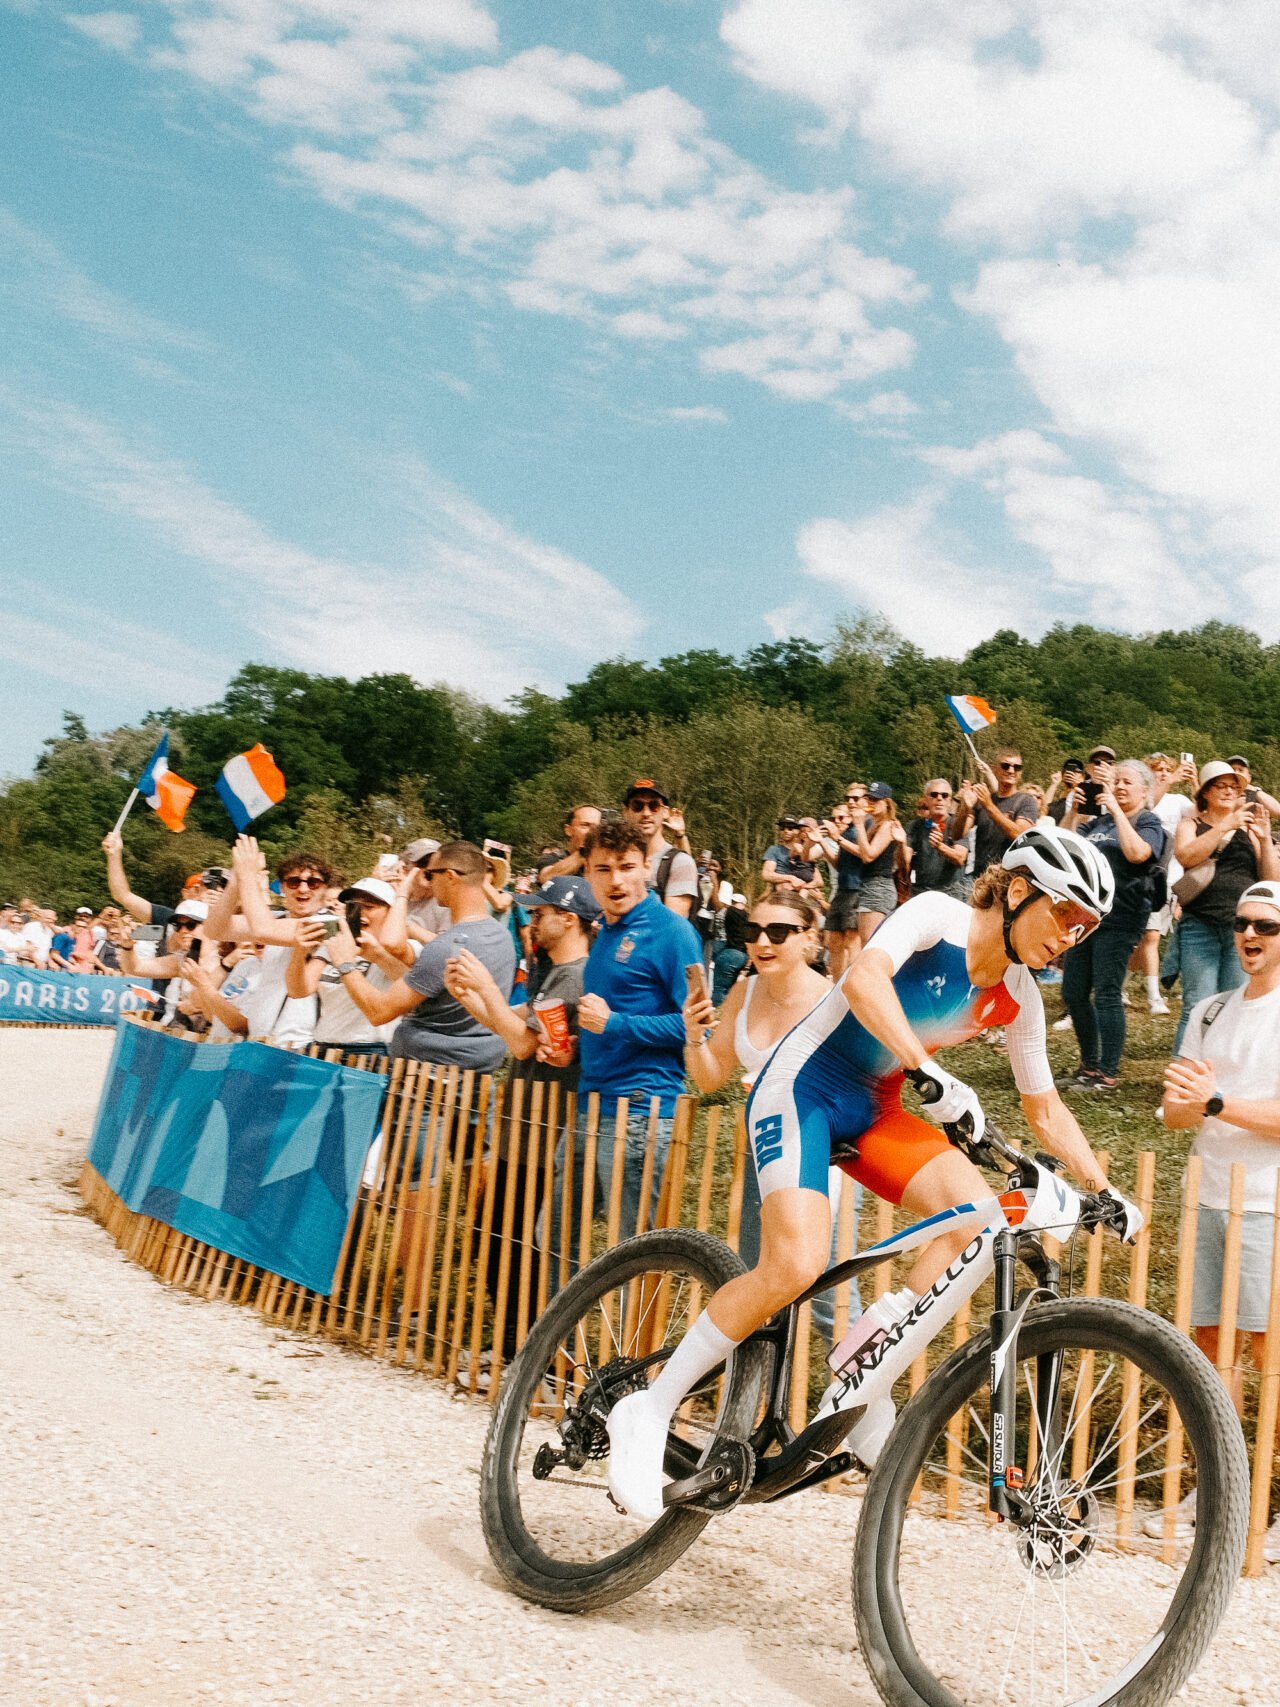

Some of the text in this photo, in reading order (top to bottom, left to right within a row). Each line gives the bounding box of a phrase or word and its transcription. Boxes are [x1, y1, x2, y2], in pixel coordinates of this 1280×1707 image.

[100, 989, 147, 1012] 20
[755, 1113, 782, 1174] FRA
[832, 1234, 983, 1411] PINARELLO
[994, 1431, 1003, 1472] SUNTOUR
